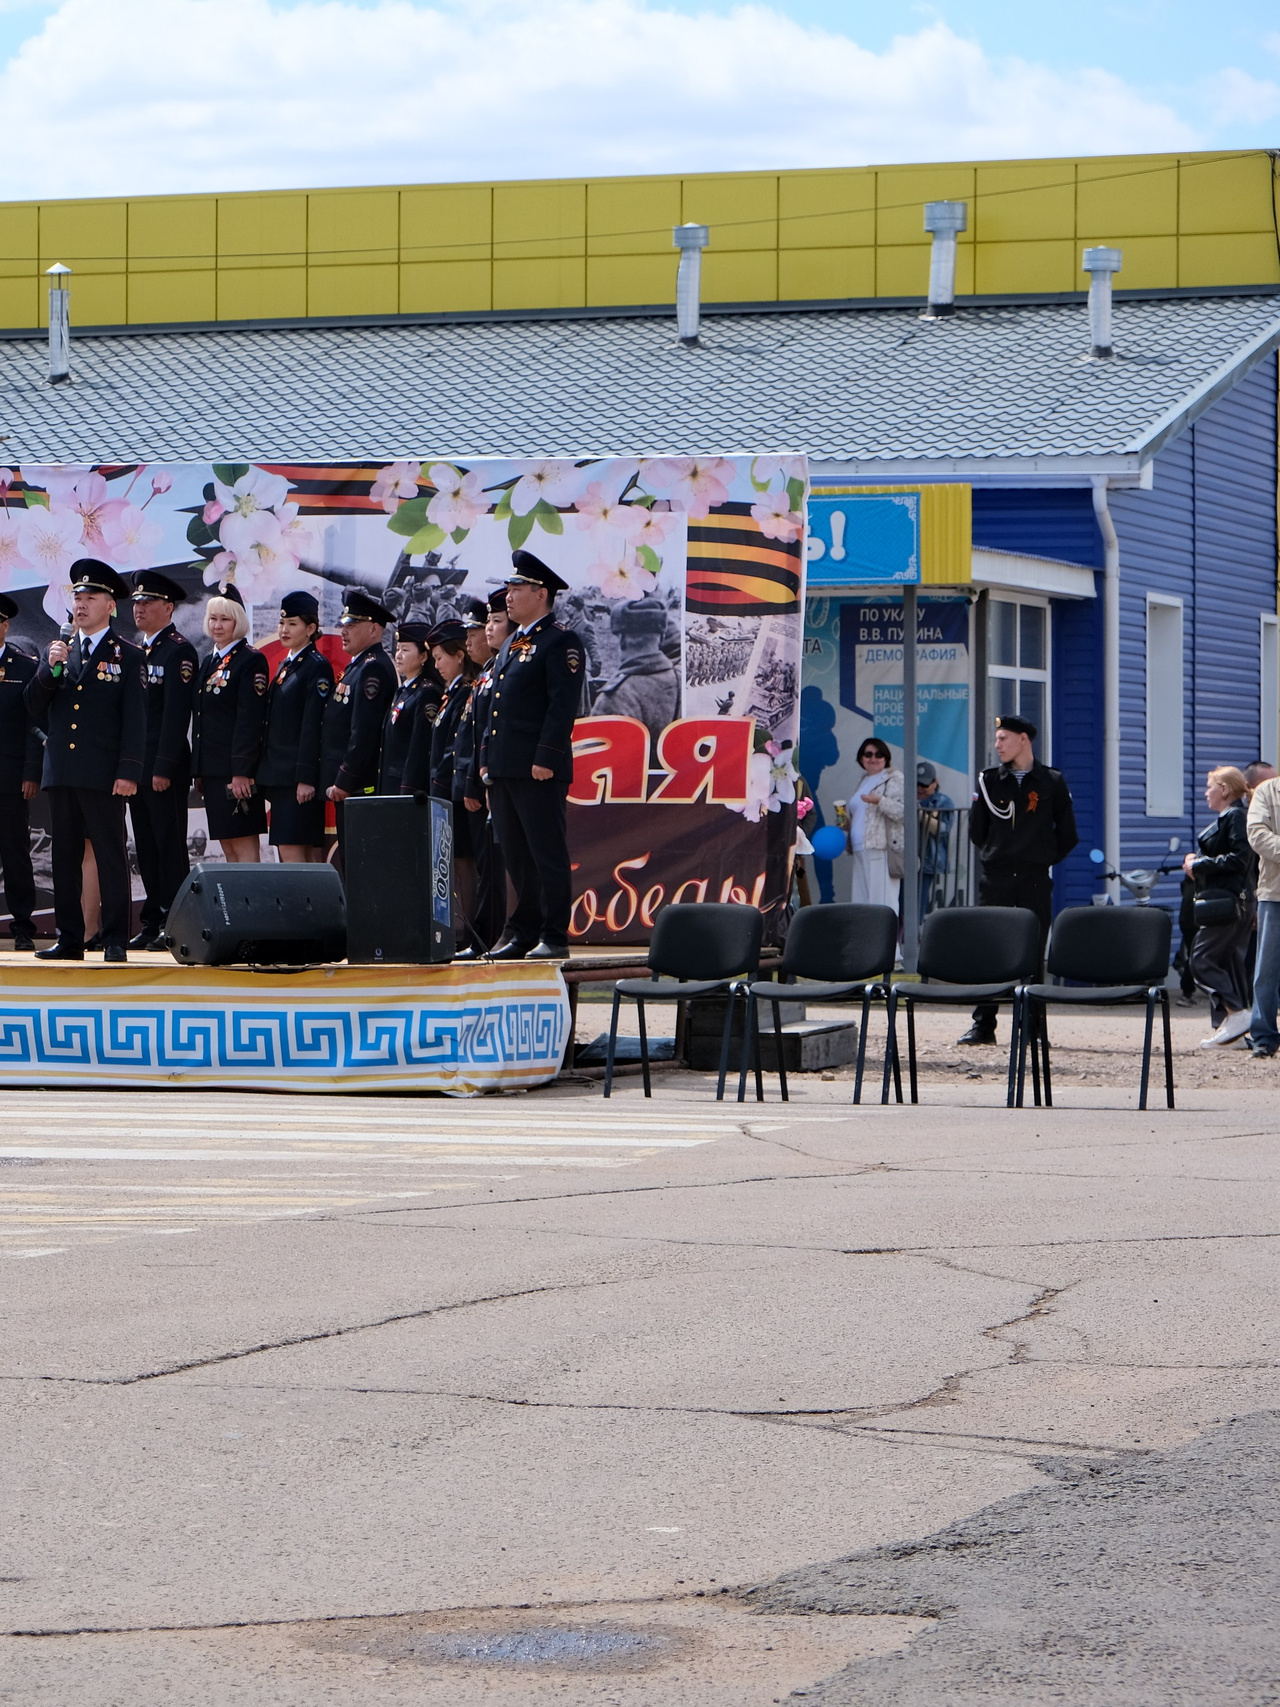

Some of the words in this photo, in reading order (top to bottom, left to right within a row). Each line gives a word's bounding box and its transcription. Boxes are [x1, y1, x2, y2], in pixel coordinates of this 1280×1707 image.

[860, 608, 879, 622] ПО
[883, 608, 926, 622] УКУ
[860, 627, 884, 641] В.В.
[888, 627, 943, 641] ПУИНА
[865, 648, 957, 664] ДЕМОАФИЯ
[874, 688, 969, 702] НАЦИНАЛЬНЫЕ
[874, 702, 928, 713] ПРОЕЫ
[874, 715, 920, 726] РОСС
[436, 818, 452, 900] 2500
